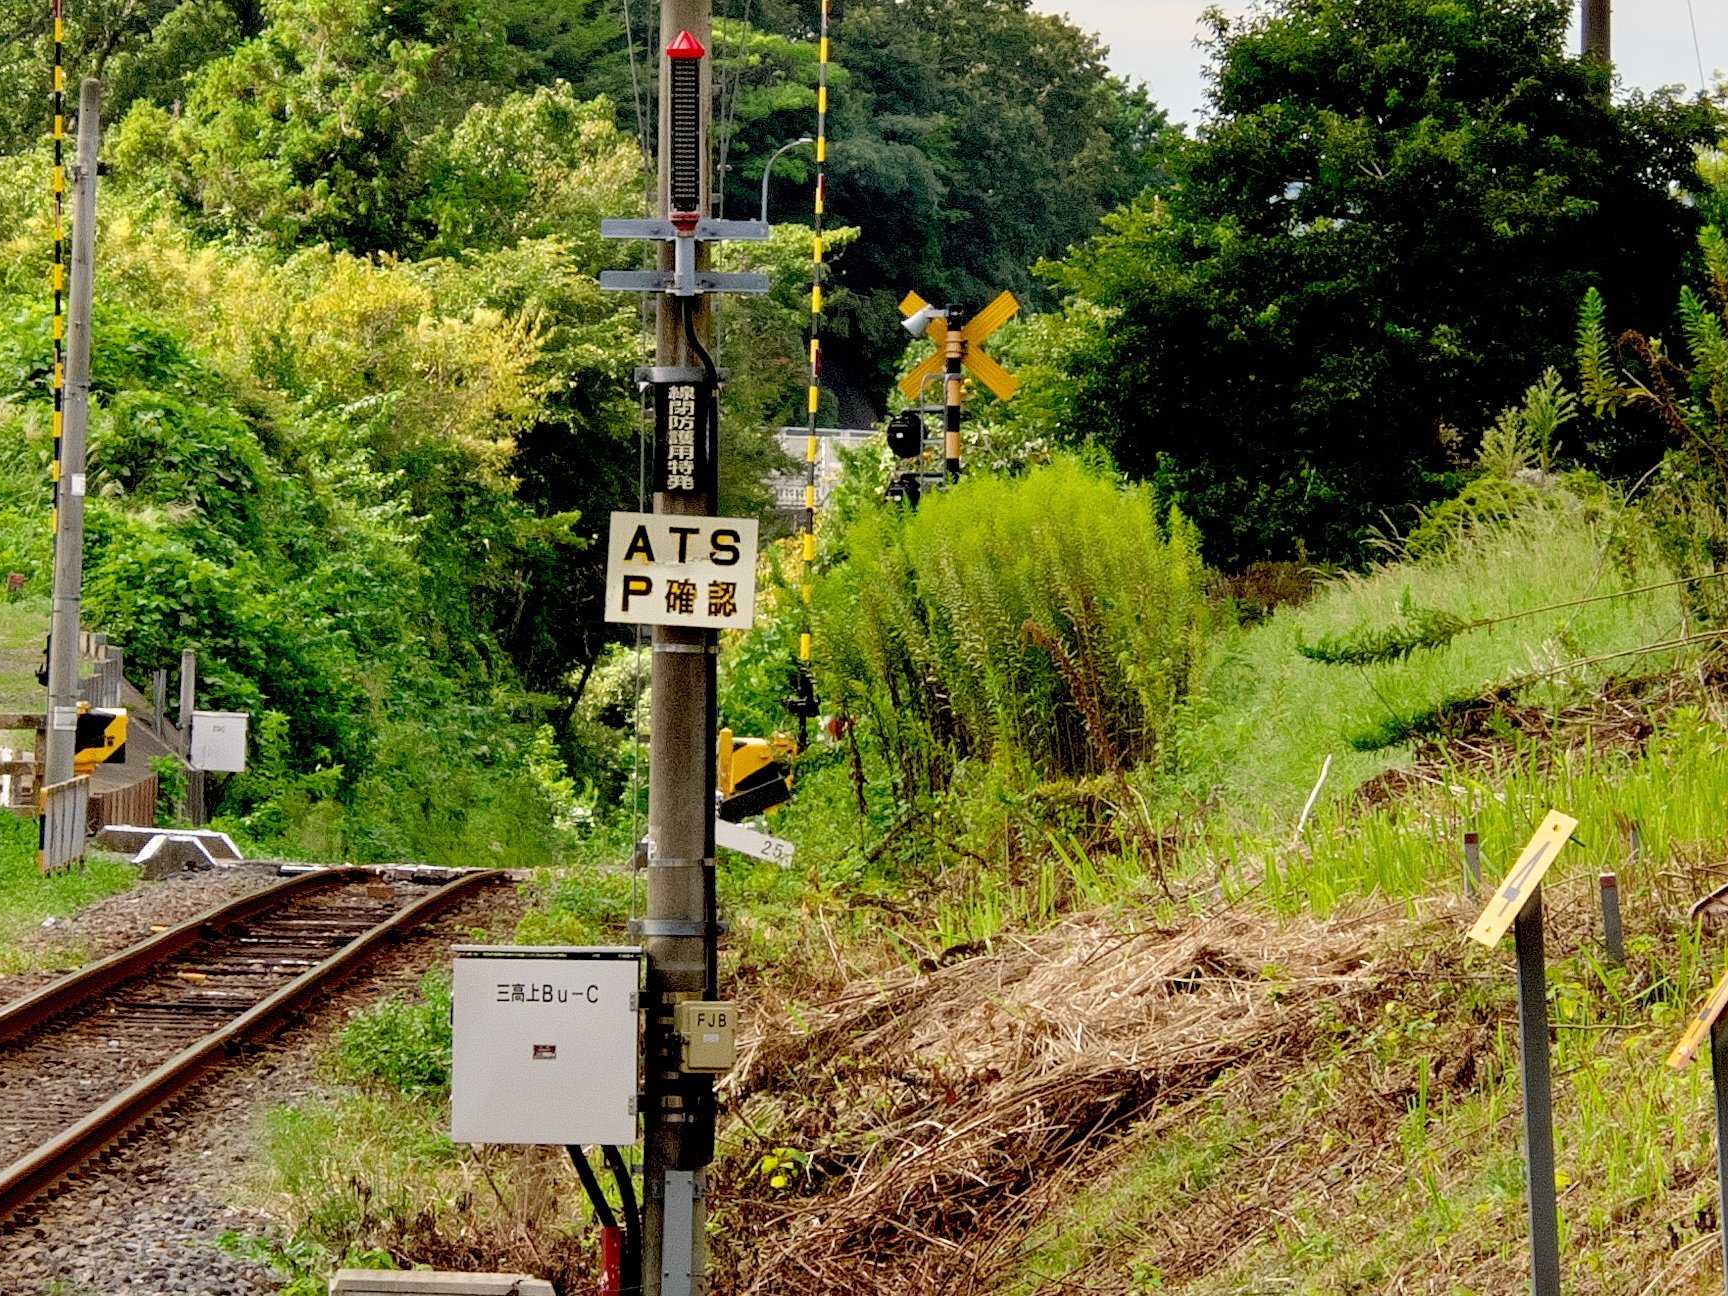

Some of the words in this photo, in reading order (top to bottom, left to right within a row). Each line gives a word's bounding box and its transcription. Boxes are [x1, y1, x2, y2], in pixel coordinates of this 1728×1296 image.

[623, 524, 741, 566] ATS
[621, 575, 738, 618] P確認
[697, 1013, 727, 1027] FJB
